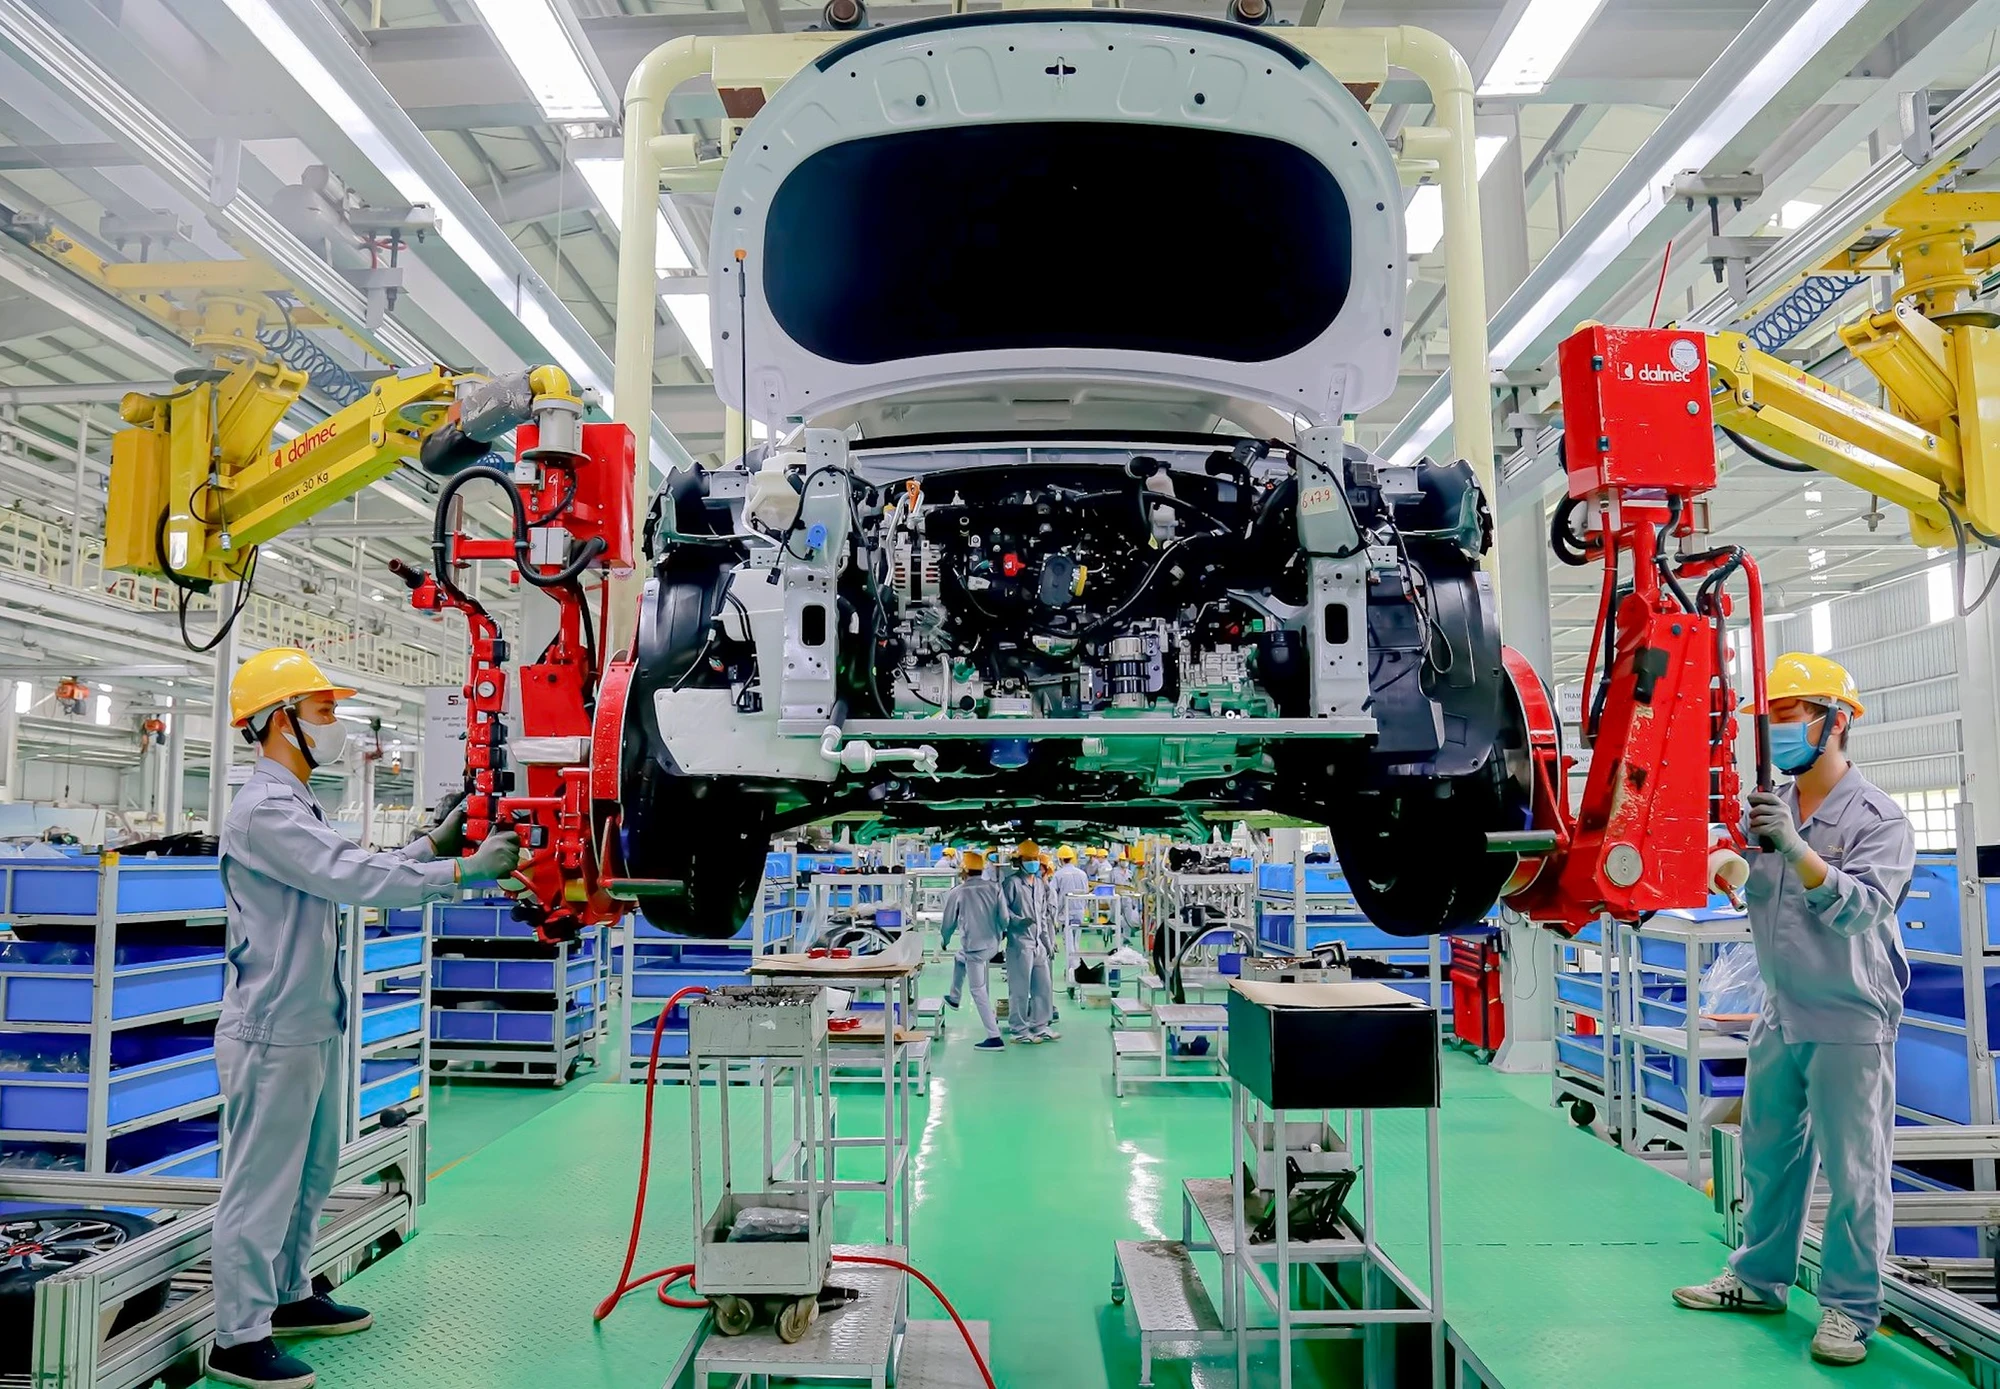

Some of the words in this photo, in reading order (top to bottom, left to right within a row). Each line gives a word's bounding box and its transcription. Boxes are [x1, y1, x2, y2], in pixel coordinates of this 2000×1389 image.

[1638, 364, 1691, 383] dalmec
[288, 423, 337, 463] dalmec
[1819, 432, 1840, 450] max
[1844, 442, 1858, 457] 30
[282, 488, 300, 505] max
[303, 478, 314, 493] 30
[316, 472, 329, 486] Kg
[1302, 489, 1331, 509] 6179
